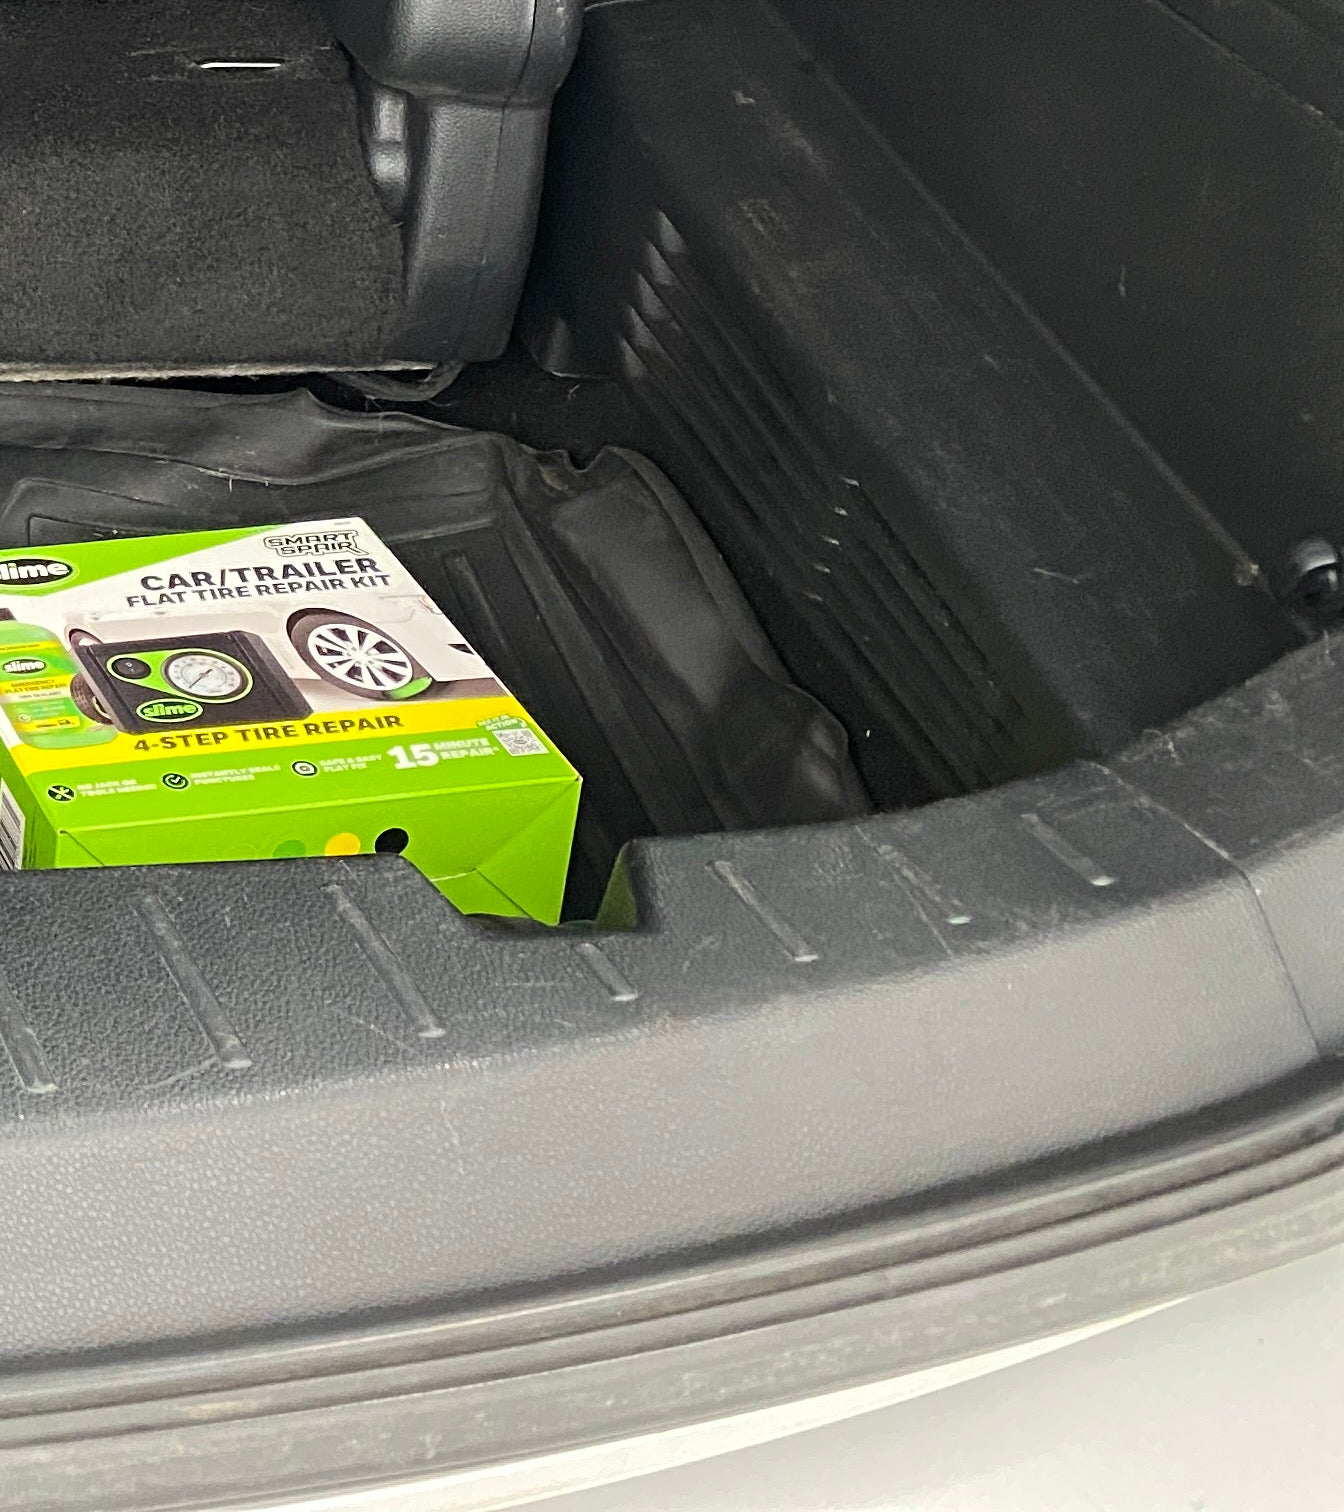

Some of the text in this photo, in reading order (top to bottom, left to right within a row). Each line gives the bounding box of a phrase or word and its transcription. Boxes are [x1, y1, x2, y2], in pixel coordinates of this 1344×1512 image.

[268, 532, 352, 546] SMART
[280, 541, 364, 556] SPAIR
[140, 557, 382, 592] CAR/TRAILER
[126, 574, 392, 608] FLAT TIRE REPAIR KIT
[3, 660, 45, 673] slime
[142, 703, 197, 718] slime
[485, 718, 518, 731] ACTION
[135, 715, 404, 751] 4-STEP TIRE REPAIR
[433, 738, 490, 750] MINUTE
[355, 754, 382, 763] EASY
[387, 743, 439, 769] 15
[190, 768, 248, 779] INSTANTLY
[193, 774, 255, 785] PUNCTURES
